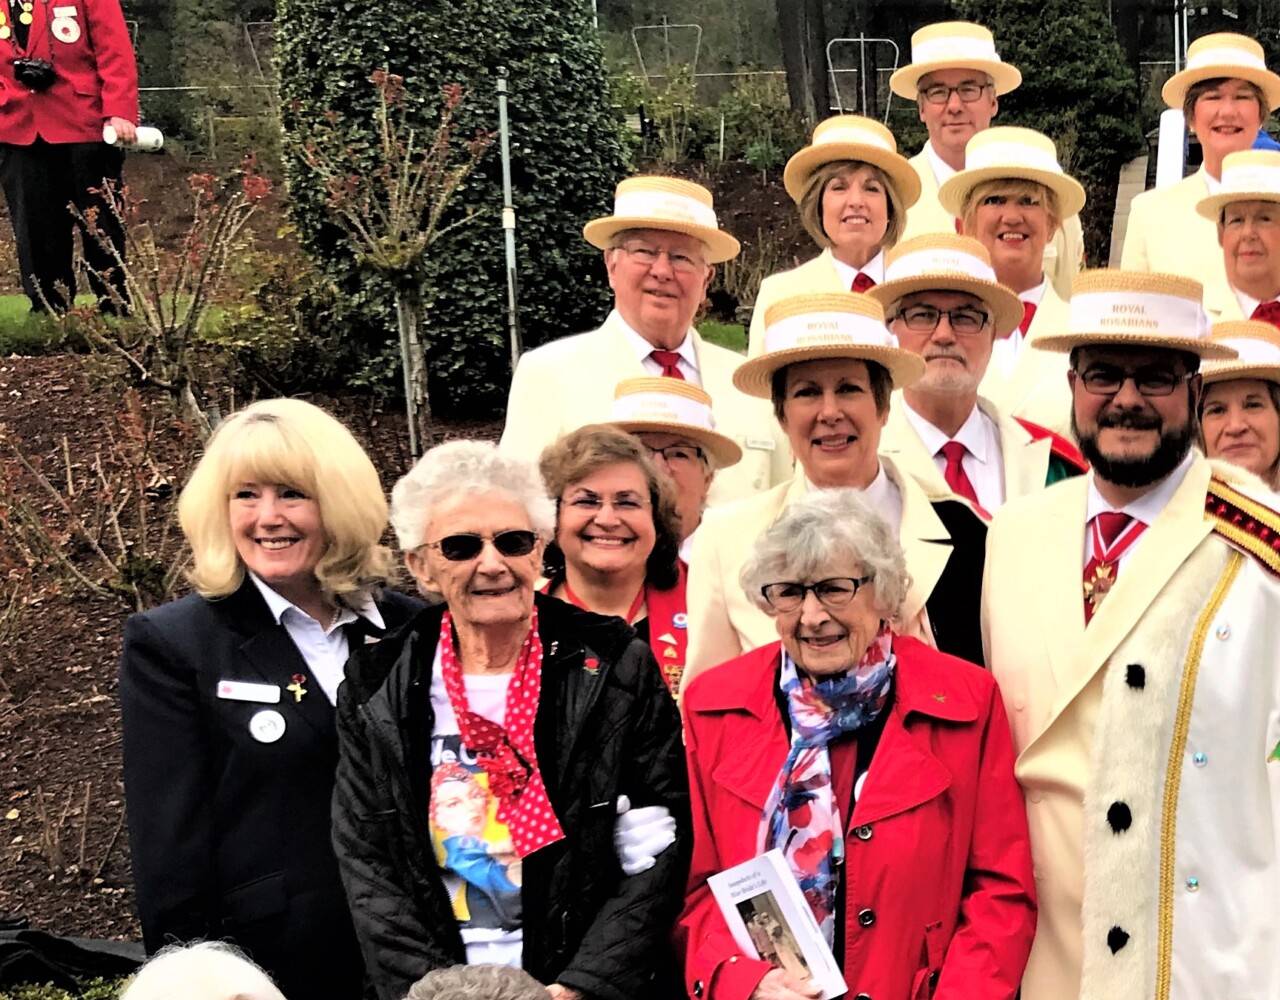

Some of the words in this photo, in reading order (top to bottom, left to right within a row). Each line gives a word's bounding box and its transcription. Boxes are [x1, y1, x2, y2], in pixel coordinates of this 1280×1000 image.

[1112, 304, 1146, 314] ROYAL
[807, 321, 839, 330] ROYAL
[1100, 318, 1159, 328] ROSARIANS
